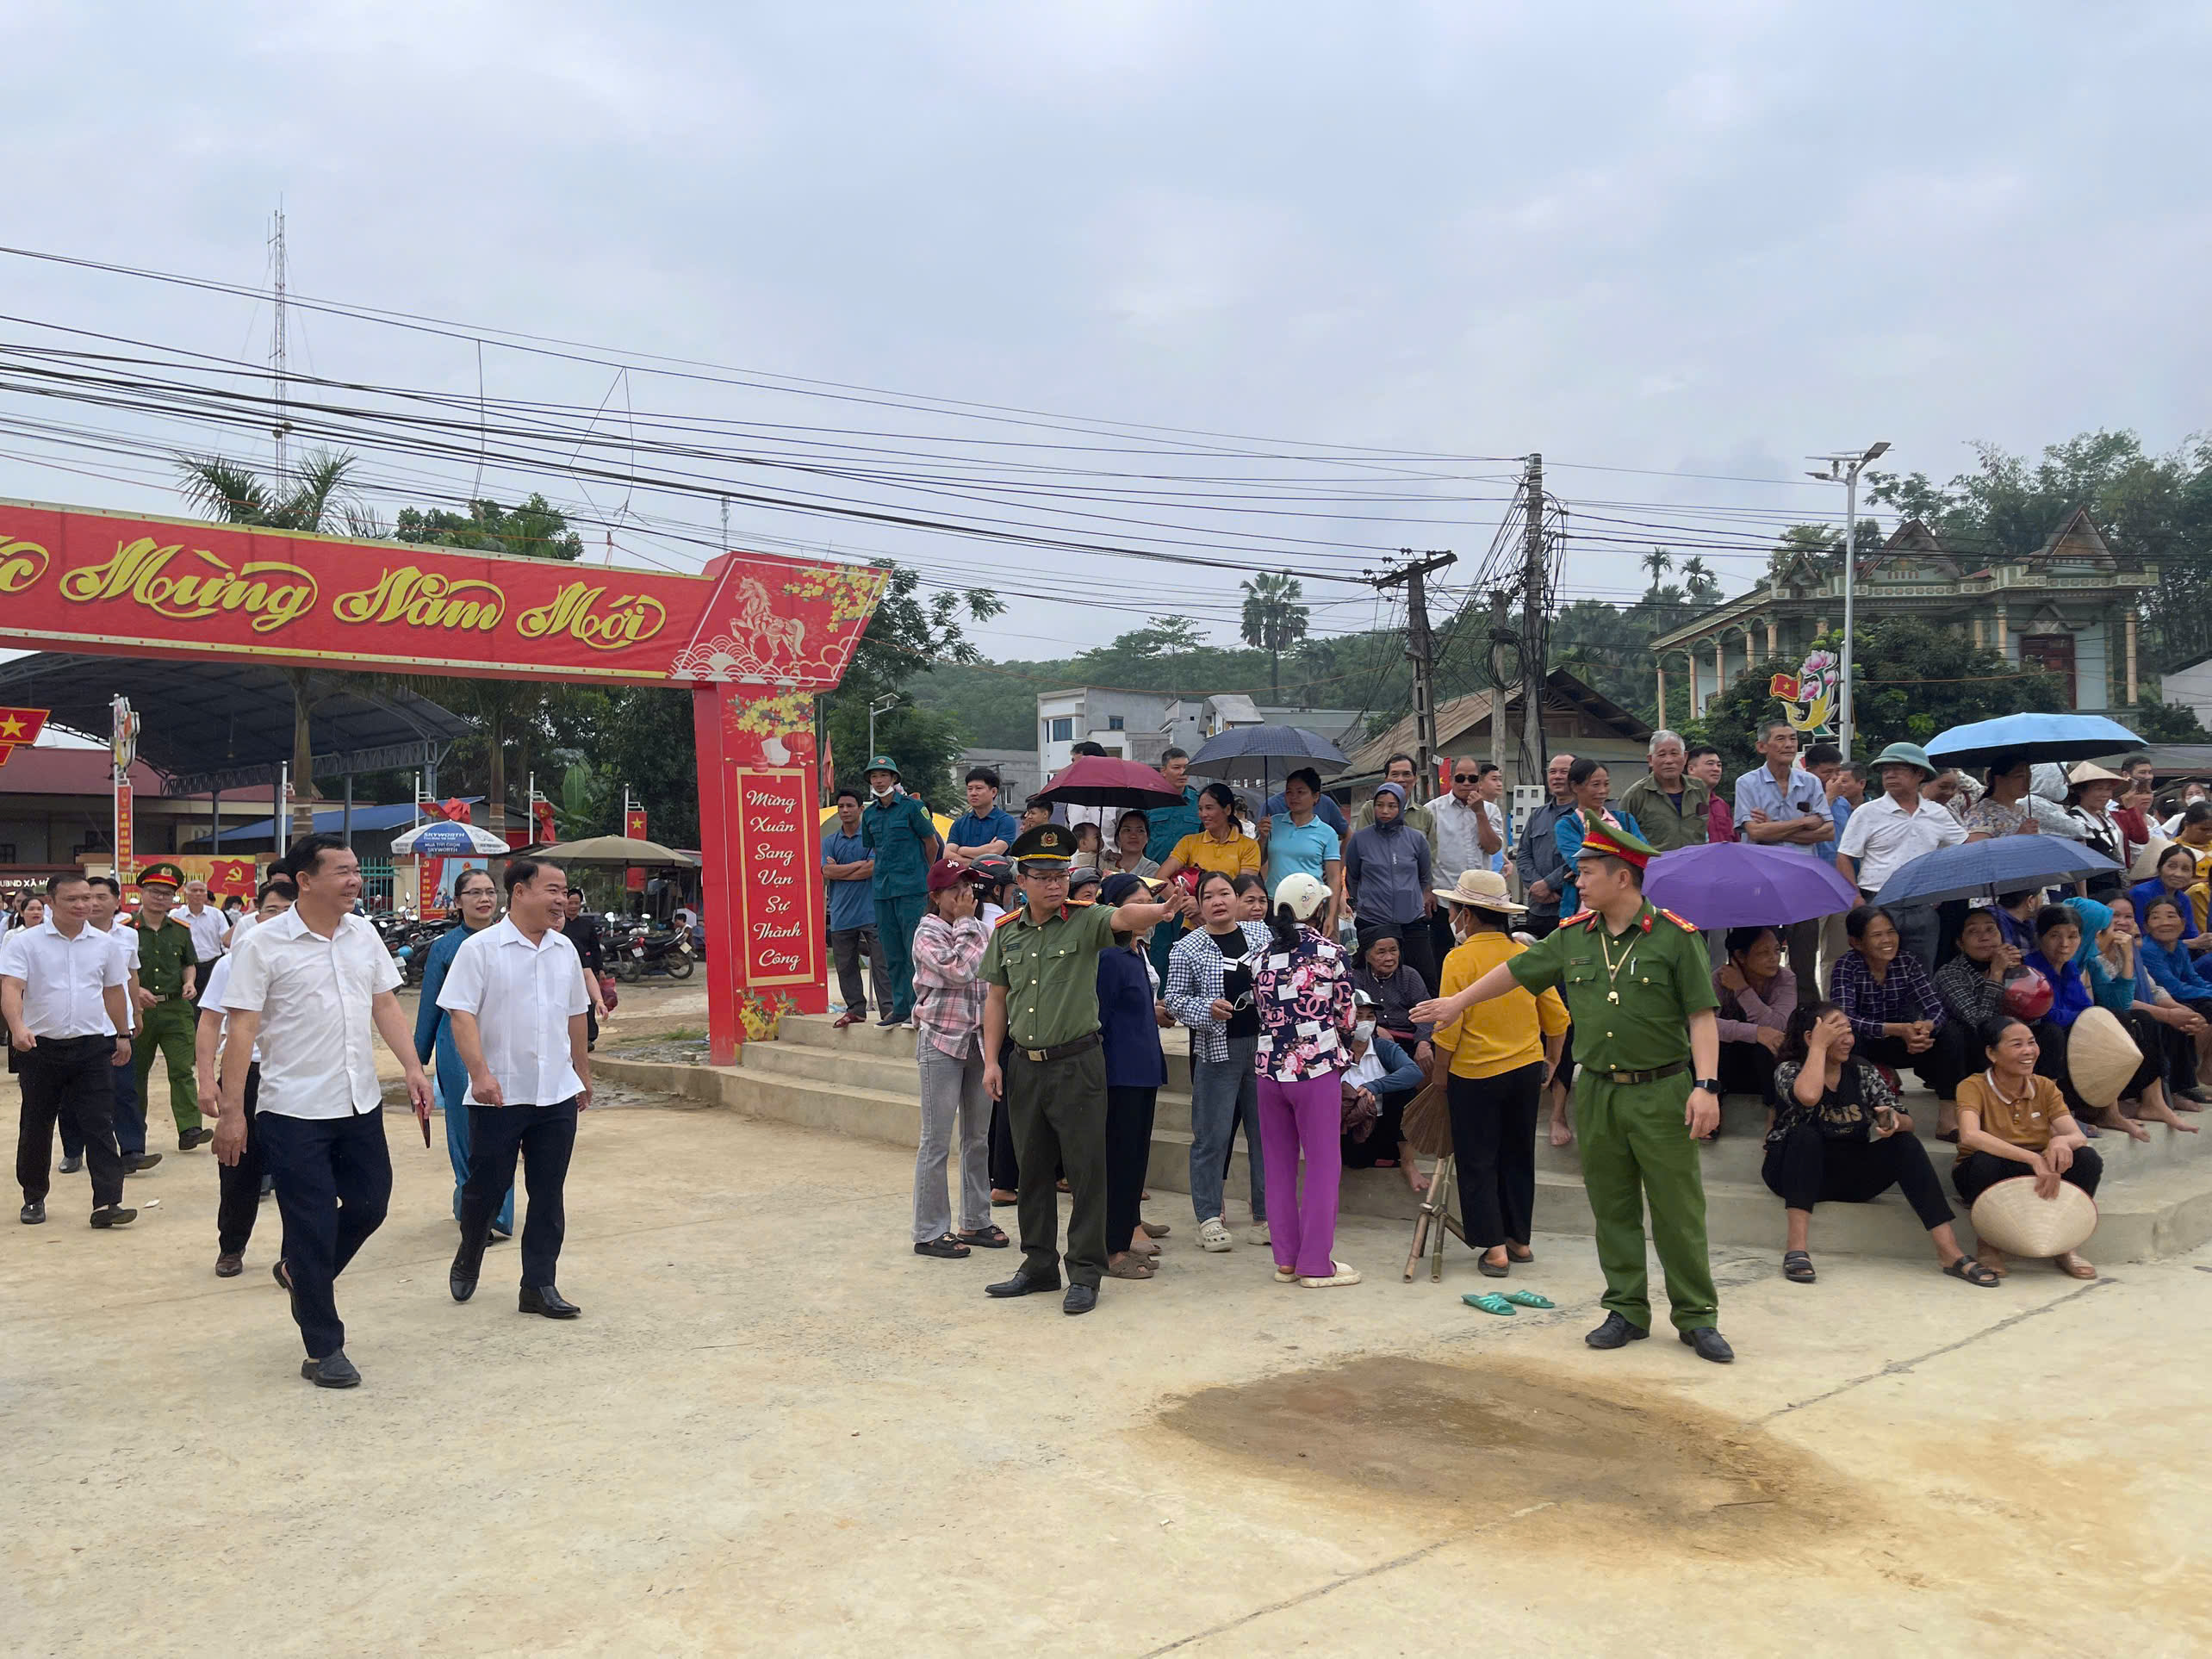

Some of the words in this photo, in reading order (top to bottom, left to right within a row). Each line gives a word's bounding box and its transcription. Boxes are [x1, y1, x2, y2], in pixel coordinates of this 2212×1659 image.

[59, 537, 319, 632] Mừng
[332, 565, 506, 631] Năm
[516, 581, 667, 649] Mới
[746, 790, 797, 813] Mừng
[750, 817, 796, 833] Xuân
[755, 843, 795, 866] Sang
[23, 878, 37, 887] XÃ
[757, 869, 793, 888] Vạn
[765, 896, 792, 914] Sự
[753, 921, 802, 940] Thành
[759, 949, 800, 971] Công
